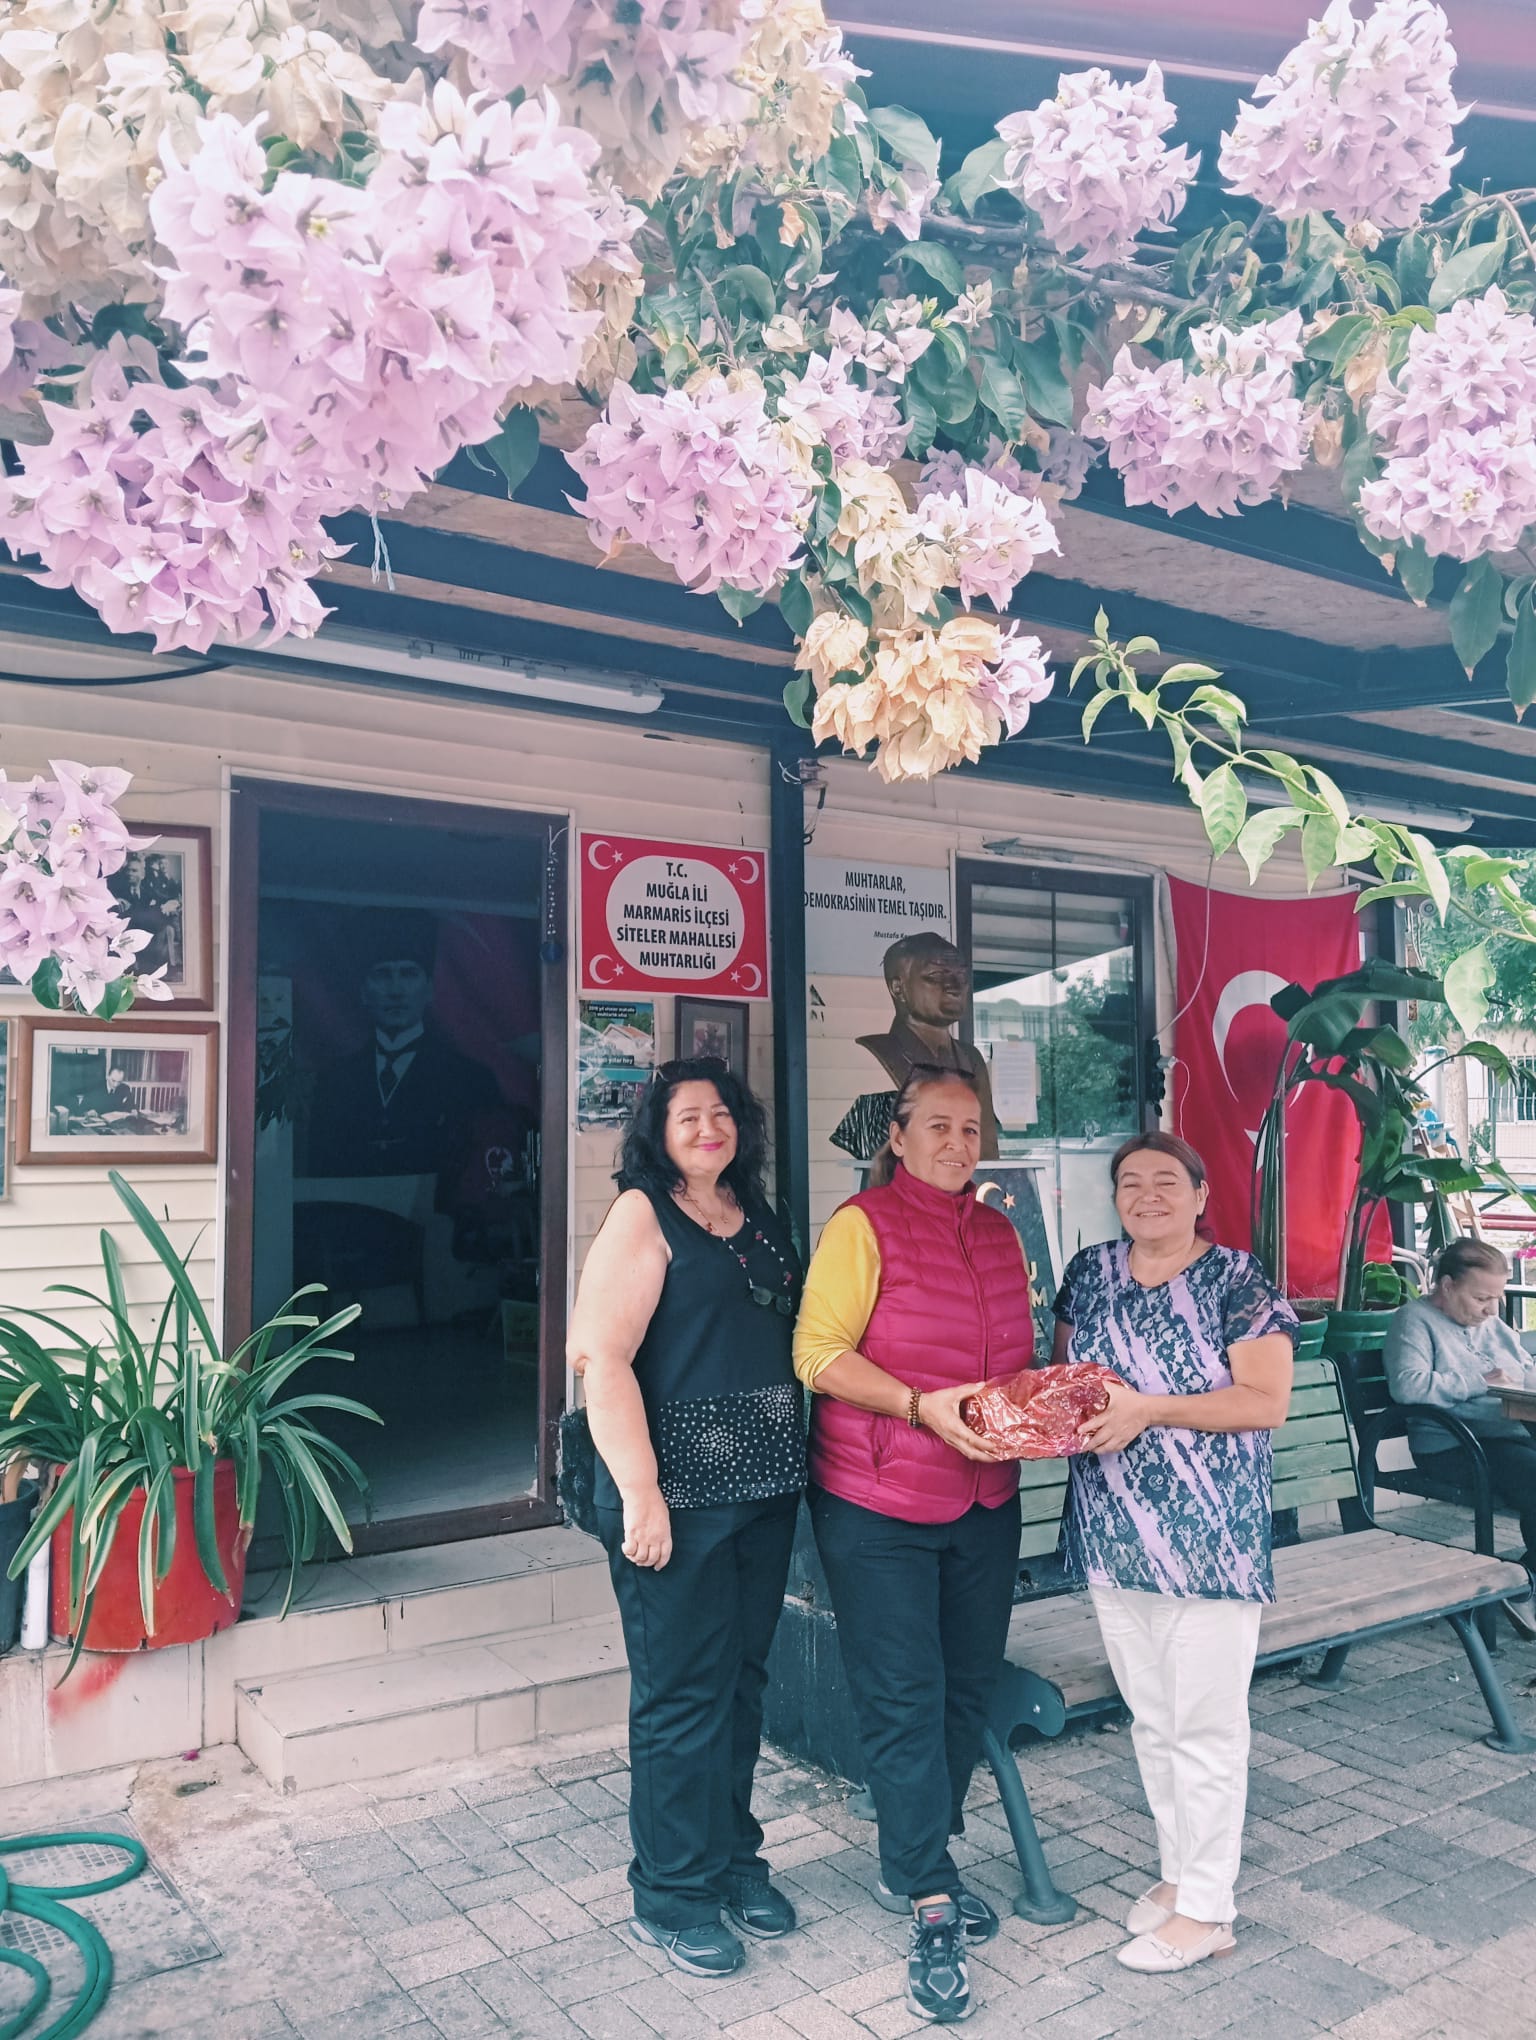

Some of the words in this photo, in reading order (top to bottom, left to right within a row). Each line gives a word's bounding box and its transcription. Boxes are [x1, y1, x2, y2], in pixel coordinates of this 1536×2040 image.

[666, 862, 687, 877] T.C.
[646, 882, 689, 900] MUĞLA
[692, 884, 708, 902] İLİ
[845, 871, 906, 893] MUHTARLAR,
[623, 904, 691, 923] MARMARİS
[694, 907, 729, 928] İLÇESİ
[804, 892, 876, 913] DEMOKRASİNİN
[878, 898, 907, 916] TEMEL
[908, 901, 947, 921] TAŞIDIR.
[616, 924, 666, 944] SİTELER
[669, 930, 736, 949] MAHALLESİ
[873, 930, 899, 940] Mustafa
[639, 951, 716, 970] MUHTARLIĞI
